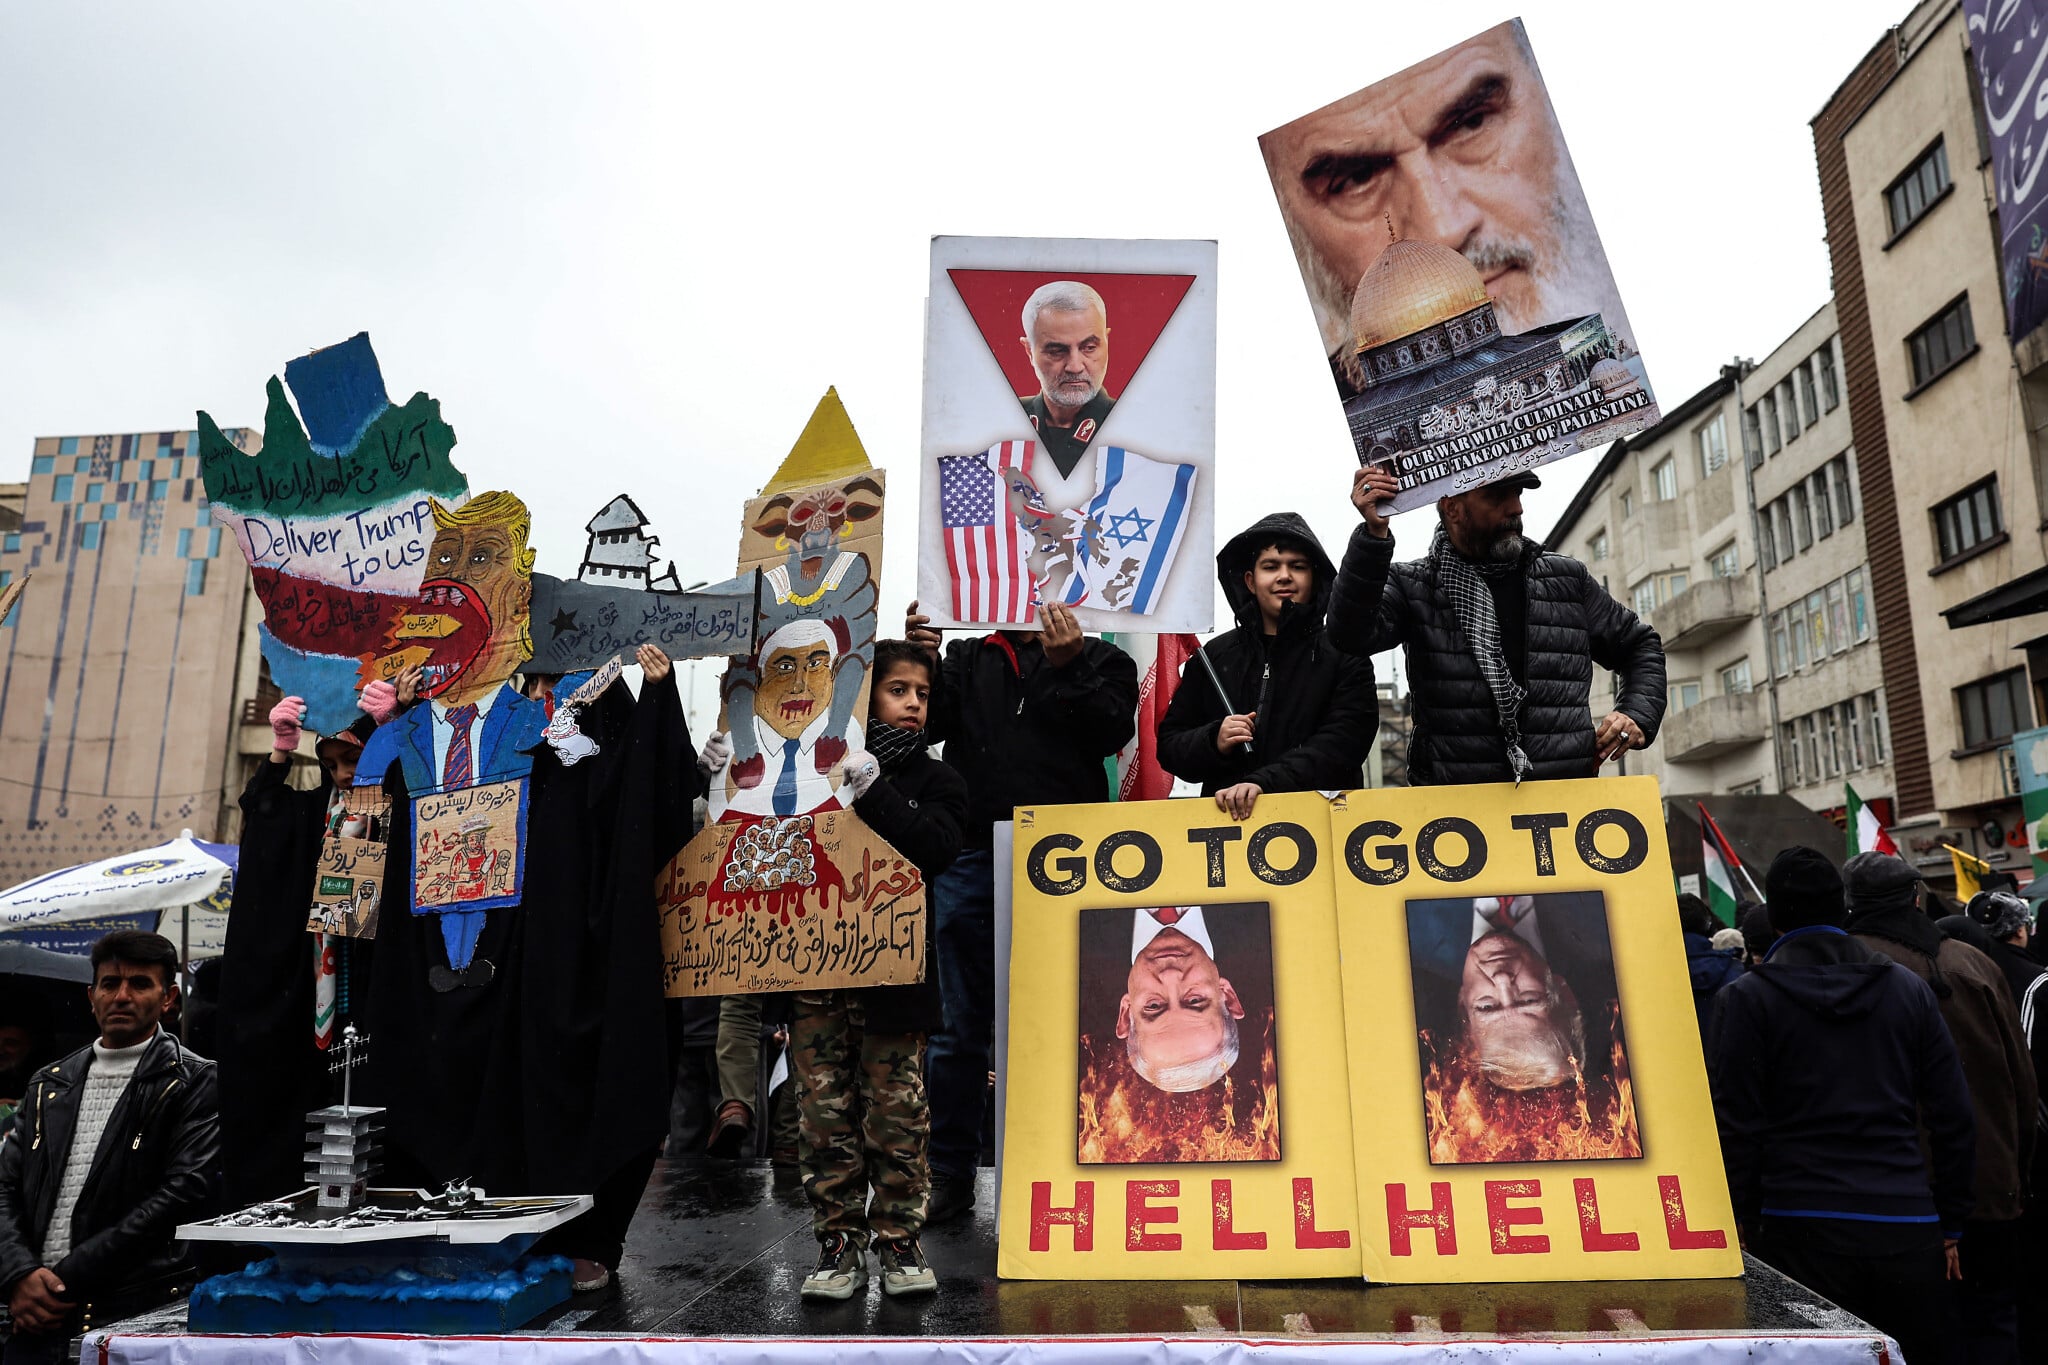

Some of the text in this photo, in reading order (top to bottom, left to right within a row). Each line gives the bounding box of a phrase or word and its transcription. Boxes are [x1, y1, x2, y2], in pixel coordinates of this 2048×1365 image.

[1402, 388, 1605, 471] OUR WAR WILL CULMINATE
[1417, 462, 1450, 483] THE
[1451, 437, 1535, 473] TAKEOVER
[1536, 425, 1557, 443] OF
[1561, 391, 1650, 434] PALESTINE
[244, 500, 432, 562] Deliver Trump
[1026, 821, 1318, 896] GO TO
[1344, 808, 1649, 886] GO TO
[1028, 1177, 1352, 1253] HELL
[1385, 1175, 1728, 1256] HELL
